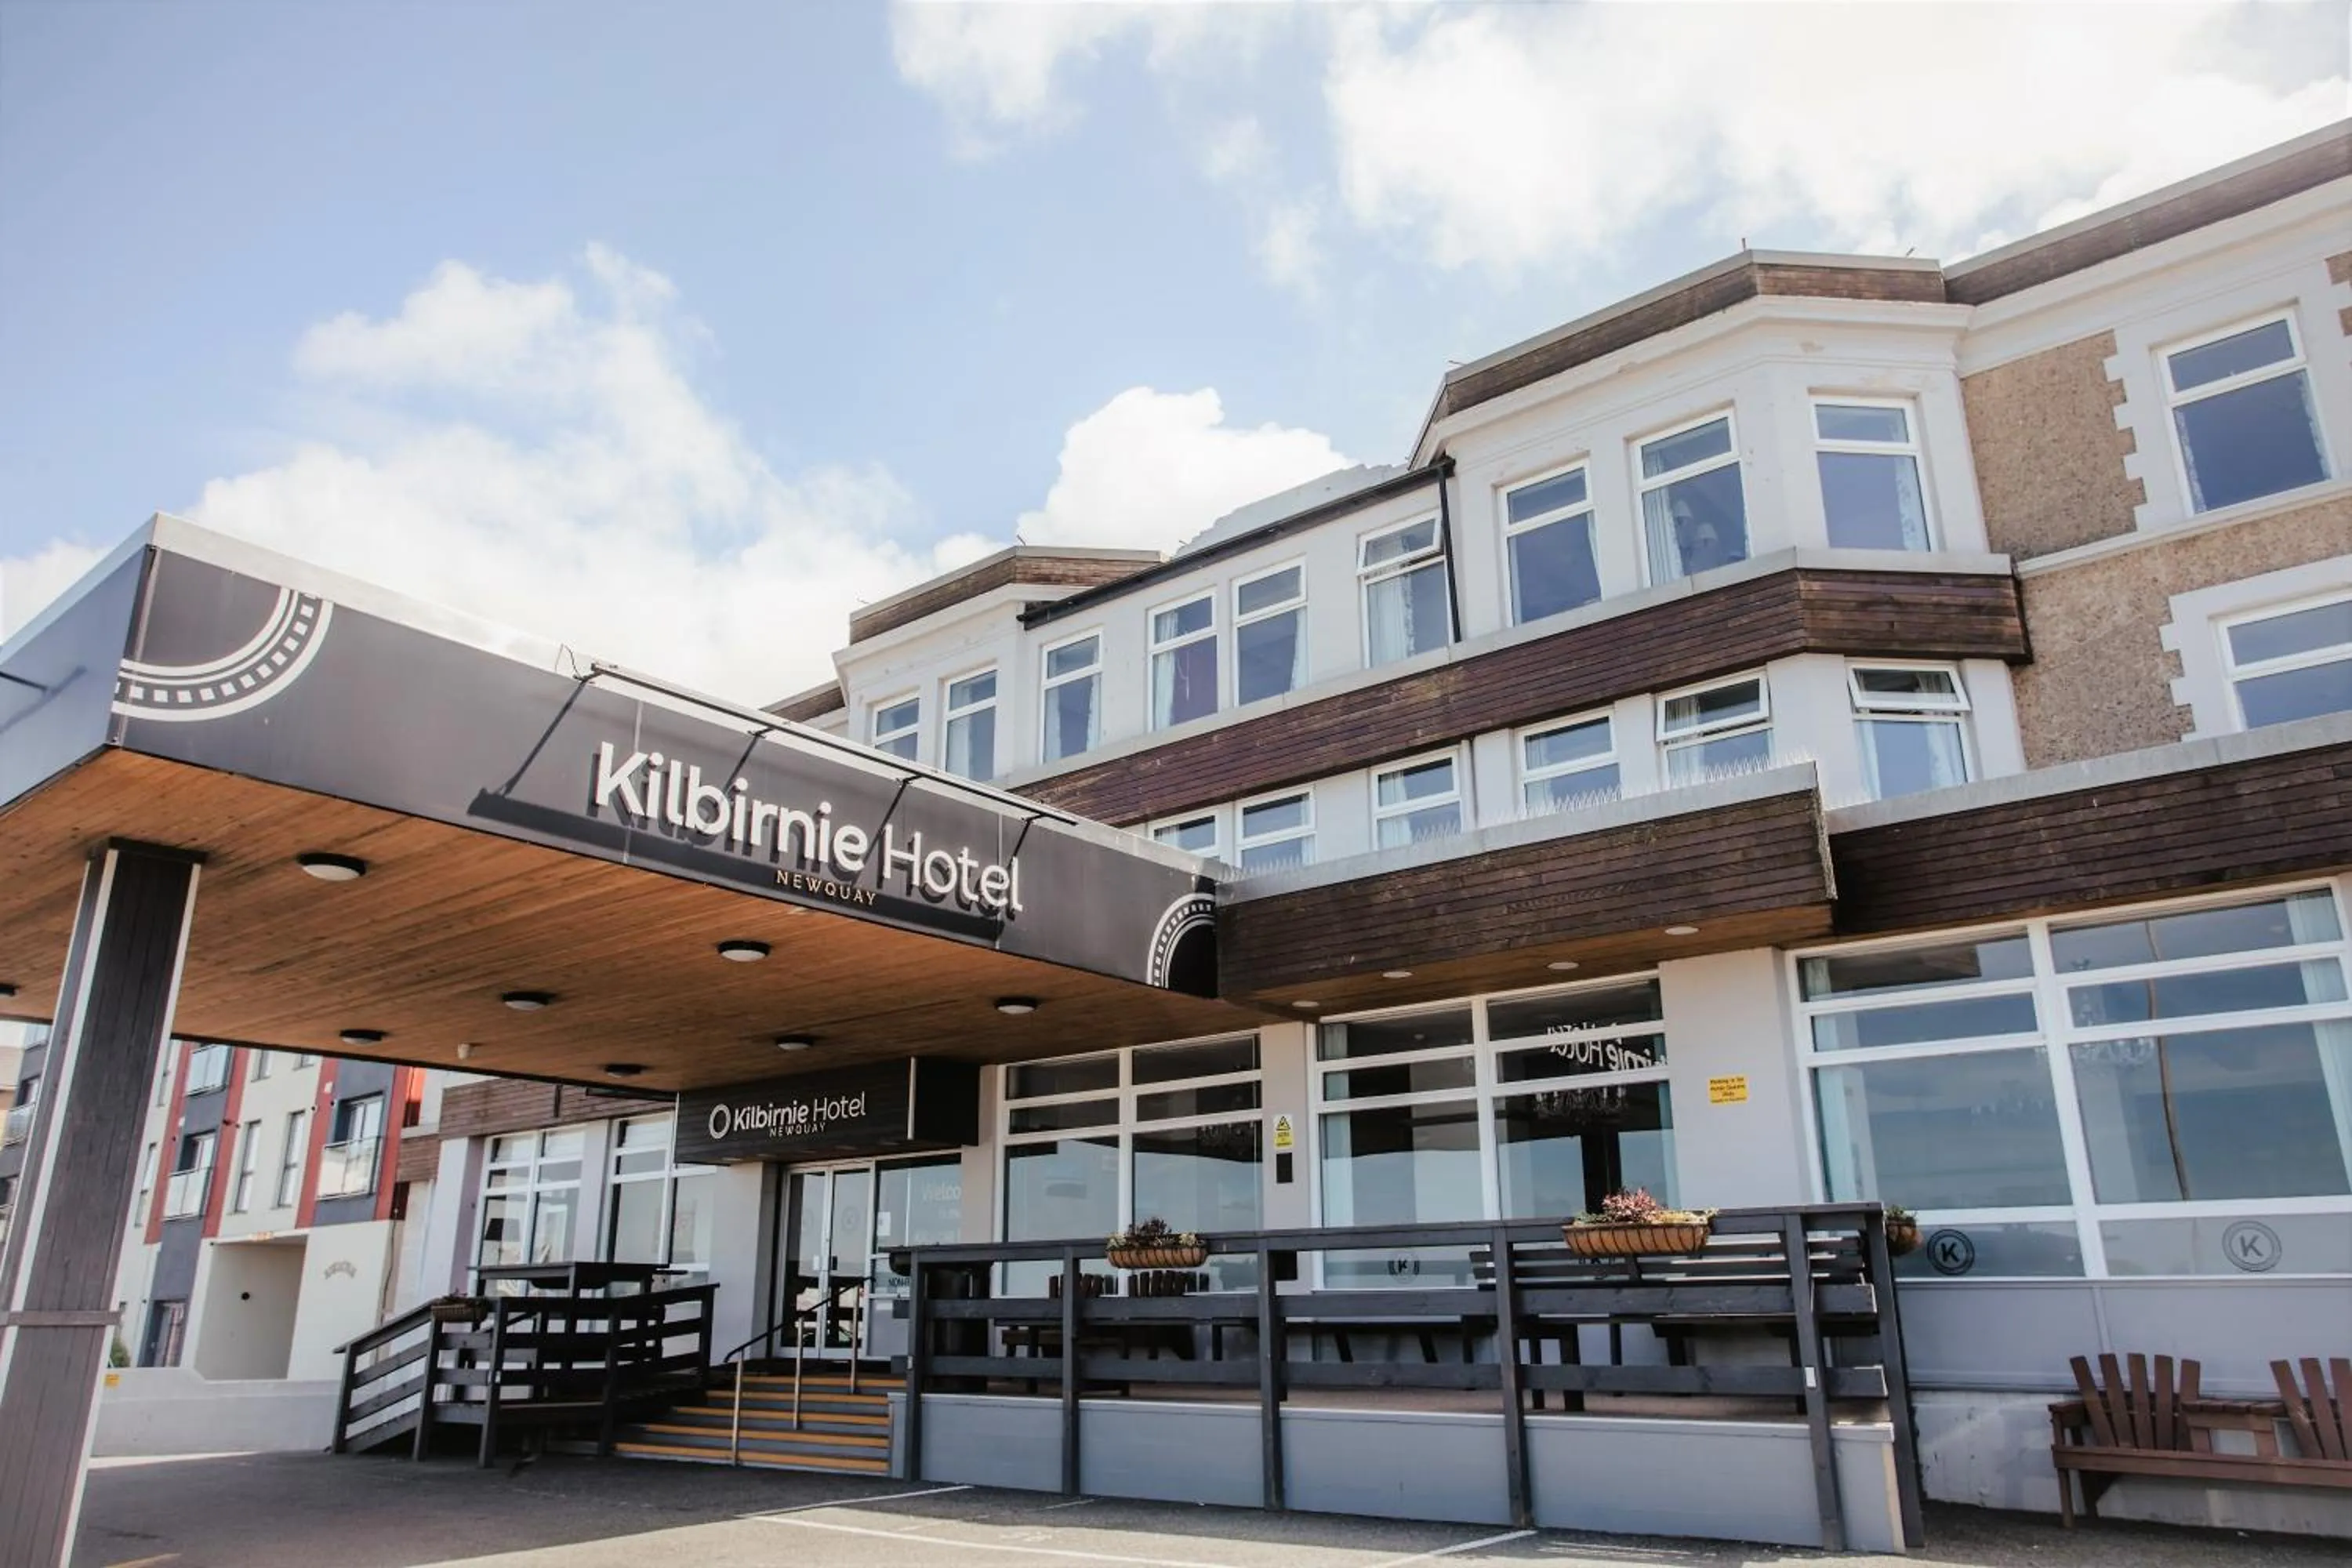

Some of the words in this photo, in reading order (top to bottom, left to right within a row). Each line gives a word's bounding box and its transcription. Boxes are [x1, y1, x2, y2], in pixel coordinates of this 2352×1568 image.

[594, 742, 868, 872] Kilbirnie
[882, 822, 1023, 913] Hotel
[776, 869, 877, 906] NEWQUAY
[734, 1100, 809, 1131] Kilbirnie
[813, 1091, 866, 1121] Hotel
[769, 1123, 826, 1138] NEWQUAY
